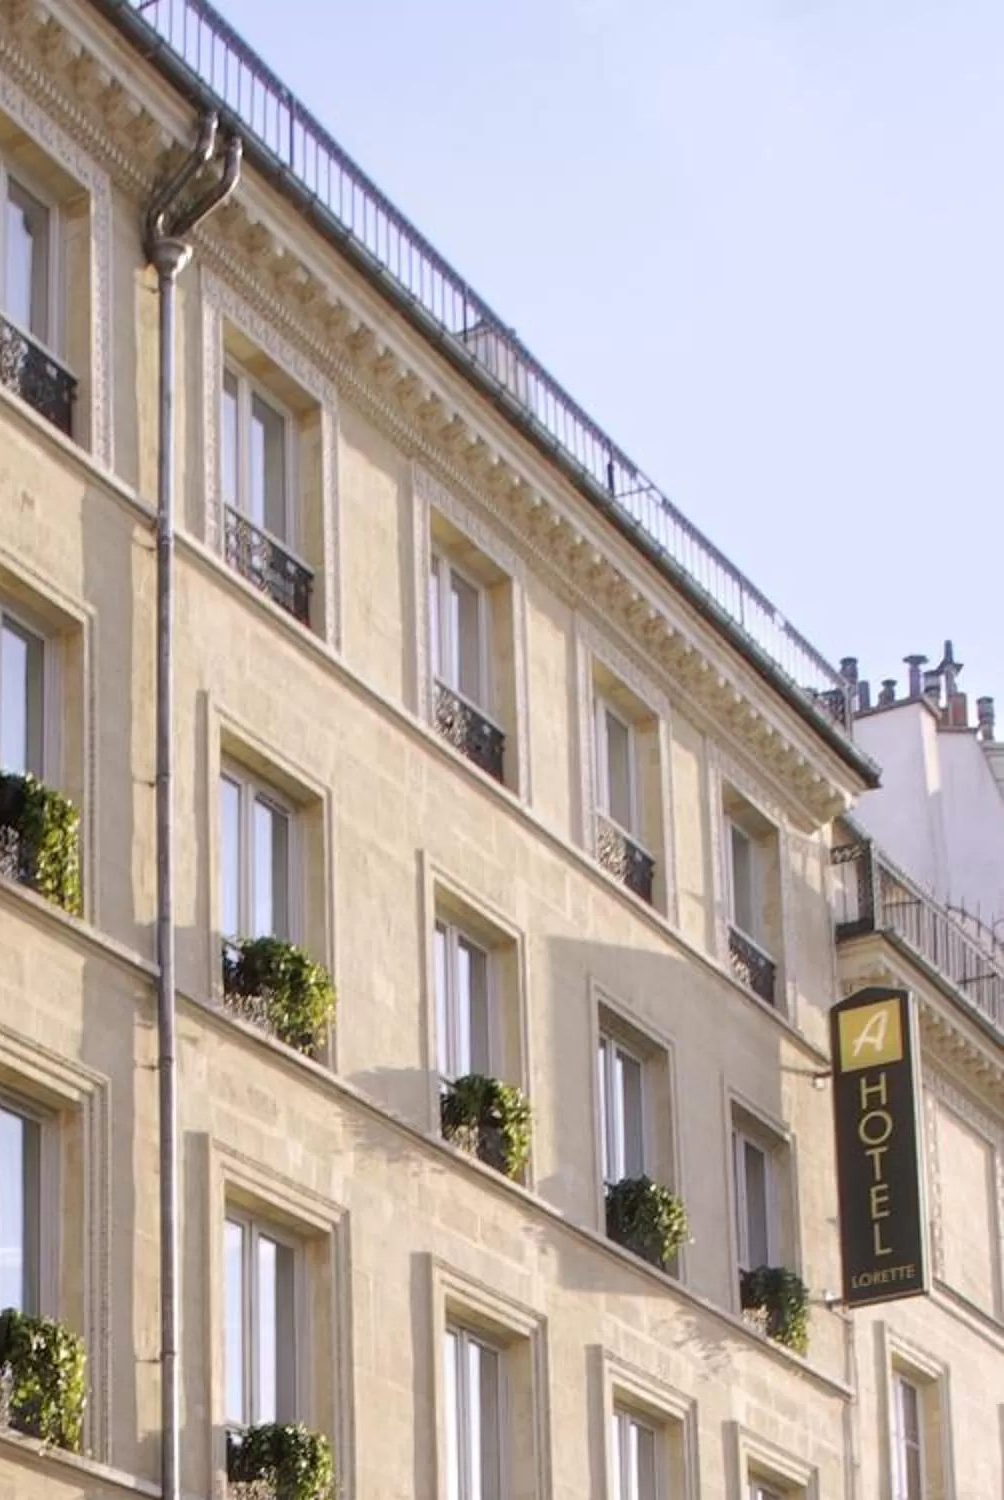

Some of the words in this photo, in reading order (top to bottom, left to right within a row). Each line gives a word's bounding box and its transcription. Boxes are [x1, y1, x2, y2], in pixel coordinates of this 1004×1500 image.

[852, 1010, 889, 1057] A
[858, 1071, 894, 1257] HOTEL
[851, 1264, 916, 1289] LORETTE
